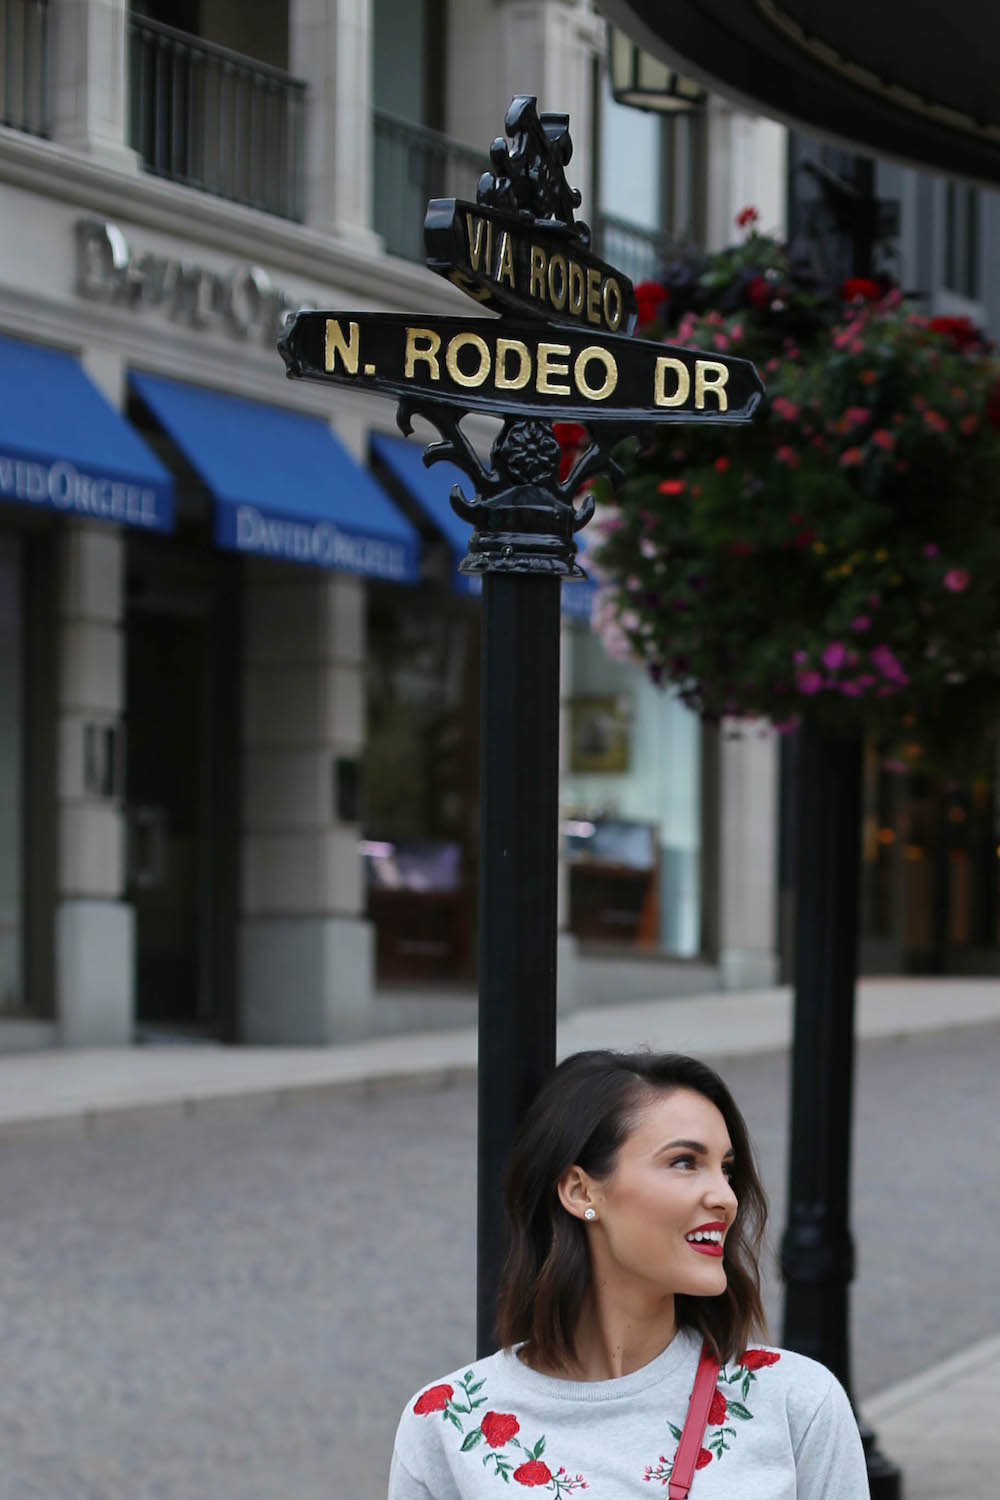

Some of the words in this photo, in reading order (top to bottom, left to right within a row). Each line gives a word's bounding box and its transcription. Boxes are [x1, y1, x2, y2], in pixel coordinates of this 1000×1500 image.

[466, 212, 516, 289] VIA
[529, 244, 623, 332] RODEO
[324, 318, 376, 376] N.
[404, 326, 618, 401] RODEO
[653, 356, 730, 412] DR
